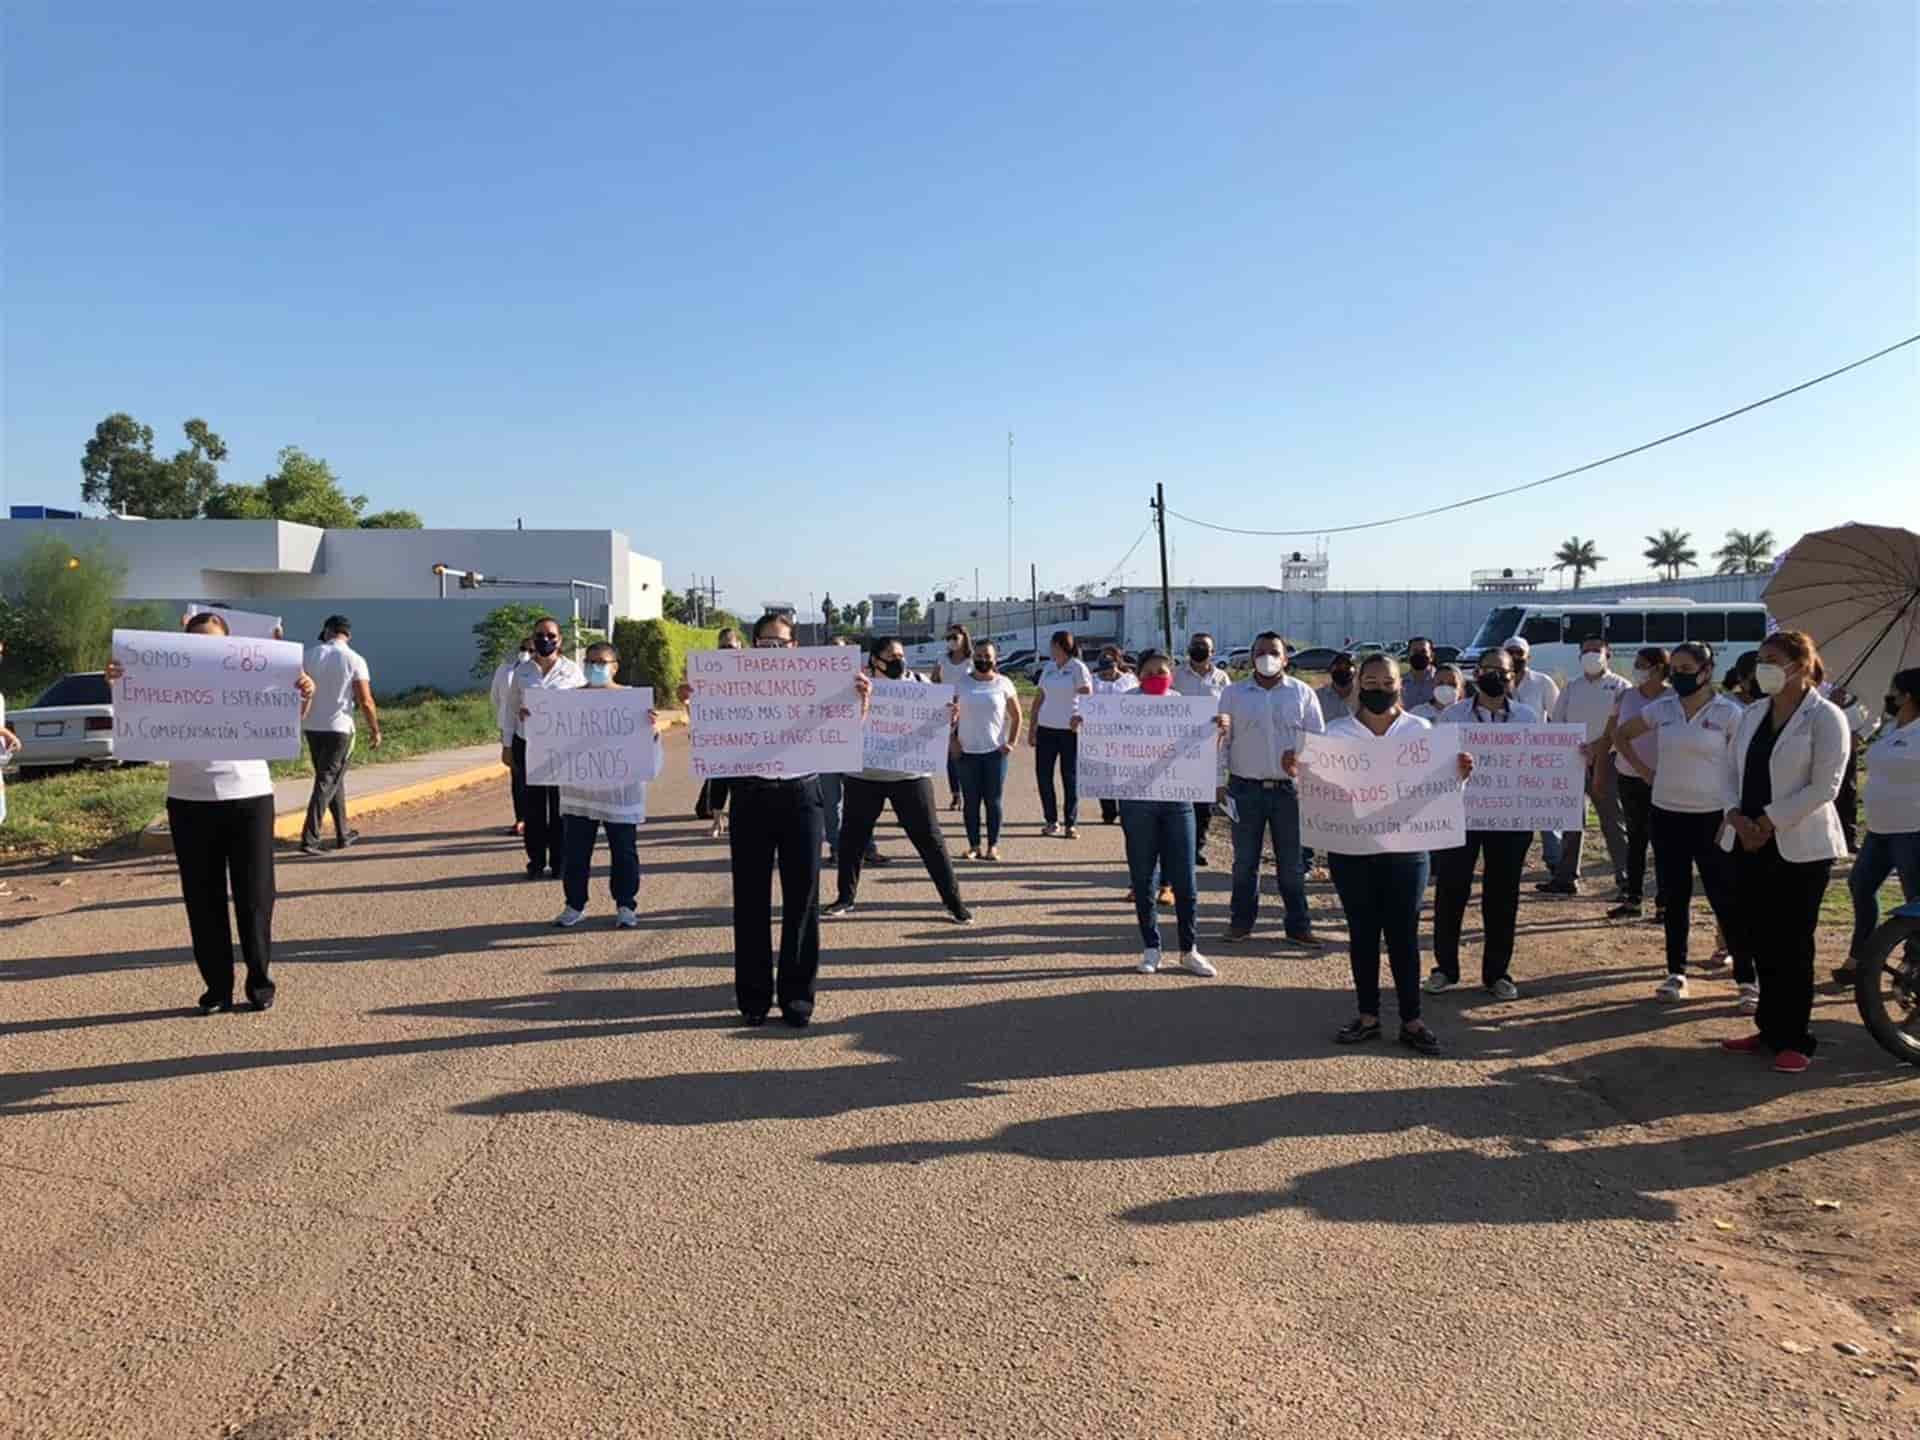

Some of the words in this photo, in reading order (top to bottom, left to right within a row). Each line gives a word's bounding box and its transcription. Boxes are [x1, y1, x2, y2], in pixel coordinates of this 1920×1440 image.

[124, 641, 192, 669] SOMOS
[221, 644, 269, 672] 285
[694, 655, 723, 673] LOS
[123, 676, 215, 704] EMPLEADOS
[222, 687, 299, 707] ESPERANDO
[693, 678, 817, 697] PENITENCIARIOS
[692, 704, 755, 721] TENEMOS
[787, 704, 801, 721] DE
[819, 704, 855, 721] MESES
[1119, 698, 1192, 718] GOBERNADOR
[116, 715, 134, 738] LA
[243, 720, 297, 738] SALARIAL
[533, 702, 635, 736] SALARIOS
[691, 727, 760, 747] ESPERANDO
[763, 730, 777, 745] EL
[780, 728, 813, 745] PAGO
[819, 728, 849, 745] DEL
[1120, 743, 1177, 759] MILLONES
[1396, 738, 1431, 767] 285
[1530, 753, 1566, 769] MESES
[544, 747, 629, 782] DIGNOS
[1159, 783, 1203, 800] ESTADO
[1497, 775, 1512, 789] EL
[1517, 775, 1545, 791] PAGO
